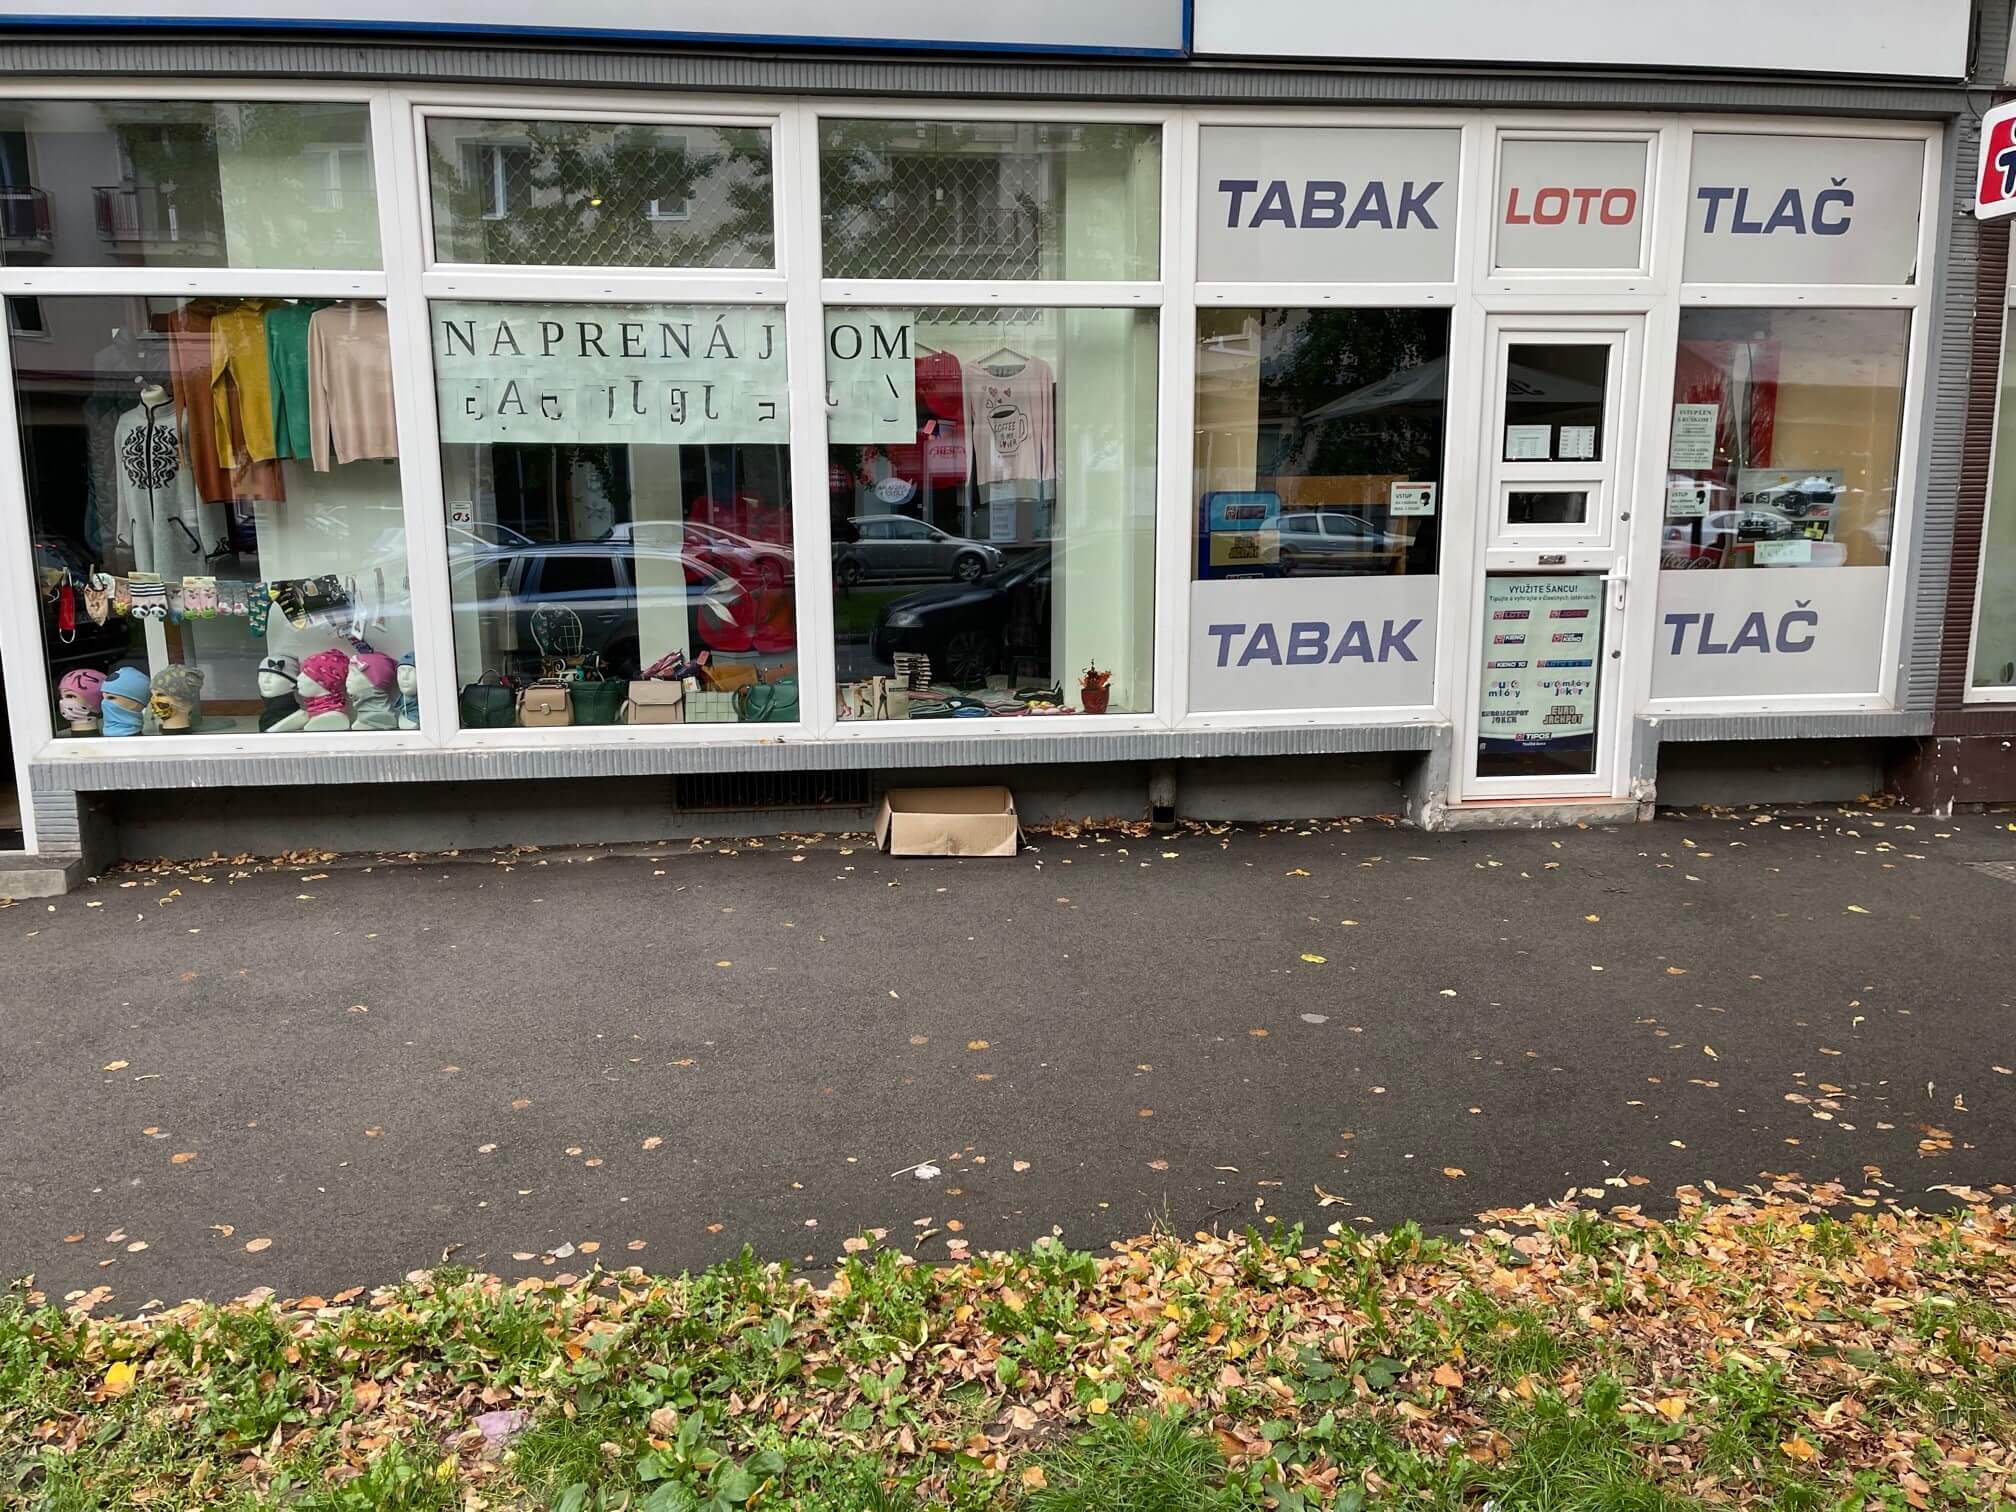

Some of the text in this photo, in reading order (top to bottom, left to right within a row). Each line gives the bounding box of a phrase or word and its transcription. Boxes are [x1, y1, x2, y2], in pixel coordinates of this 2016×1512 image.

[1217, 179, 1444, 230] TABAK
[1505, 187, 1637, 226] LOTO
[1697, 177, 1856, 236] TLAČ
[1509, 583, 1578, 593] VYUŽITE ŠANCU!
[1208, 619, 1423, 667] TABAK
[1664, 600, 1818, 655] TLAČ
[1551, 706, 1576, 715] EURO
